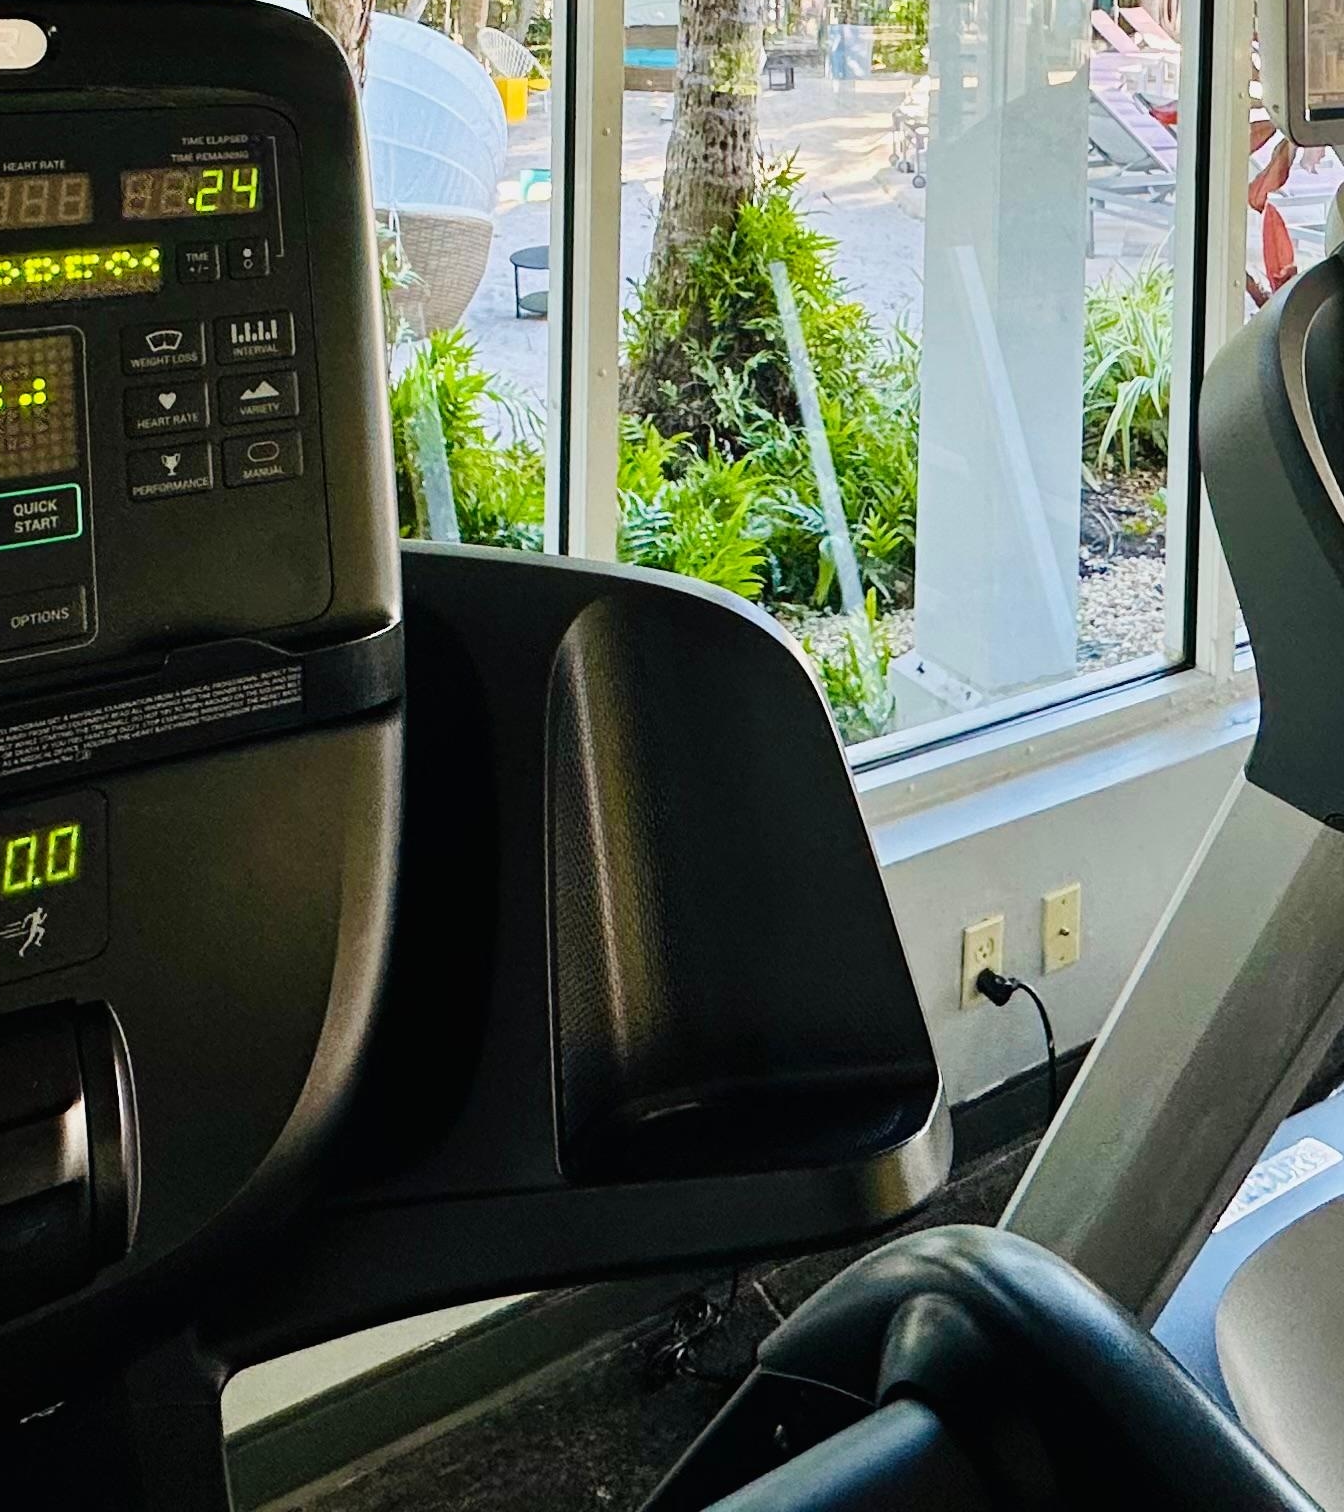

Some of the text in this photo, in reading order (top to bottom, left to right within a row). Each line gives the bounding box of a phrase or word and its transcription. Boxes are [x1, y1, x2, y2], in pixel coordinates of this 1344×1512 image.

[181, 134, 249, 145] TIME ELAPSED
[170, 150, 249, 162] TIME REMAINING
[3, 159, 66, 172] HEART RATE
[185, 252, 209, 261] TIME
[232, 345, 279, 356] INTERVAL
[130, 352, 198, 368] WEIGHT LOSS
[239, 403, 280, 416] VARIETY
[137, 413, 199, 429] HEART RATE
[242, 466, 284, 479] MANUAL
[132, 477, 209, 496] PERFORMANCE
[12, 498, 58, 516] QUICK
[14, 515, 59, 534] START
[10, 606, 70, 629] OPTIONS
[3, 824, 81, 893] 0.0
